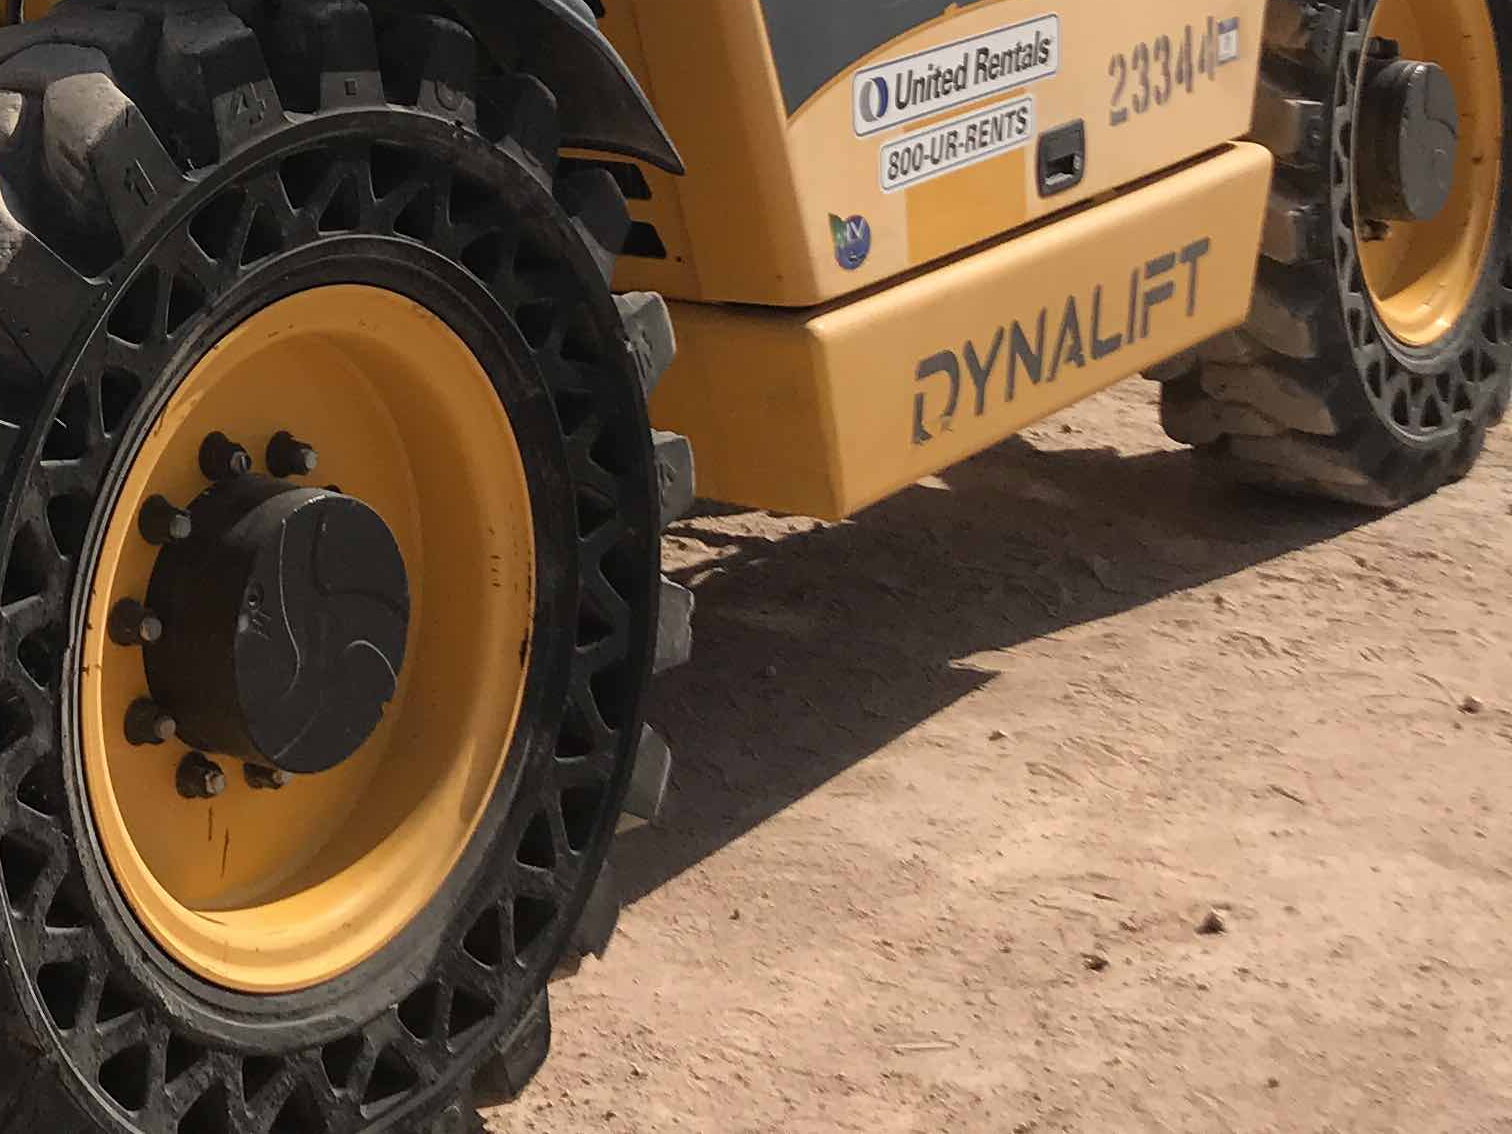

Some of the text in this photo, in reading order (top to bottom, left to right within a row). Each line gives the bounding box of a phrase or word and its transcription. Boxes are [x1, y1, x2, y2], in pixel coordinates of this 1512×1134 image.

[894, 30, 1051, 110] United Rentals
[887, 105, 1029, 181] 800-UR-RENTS
[911, 236, 1211, 445] DYNALIFT
